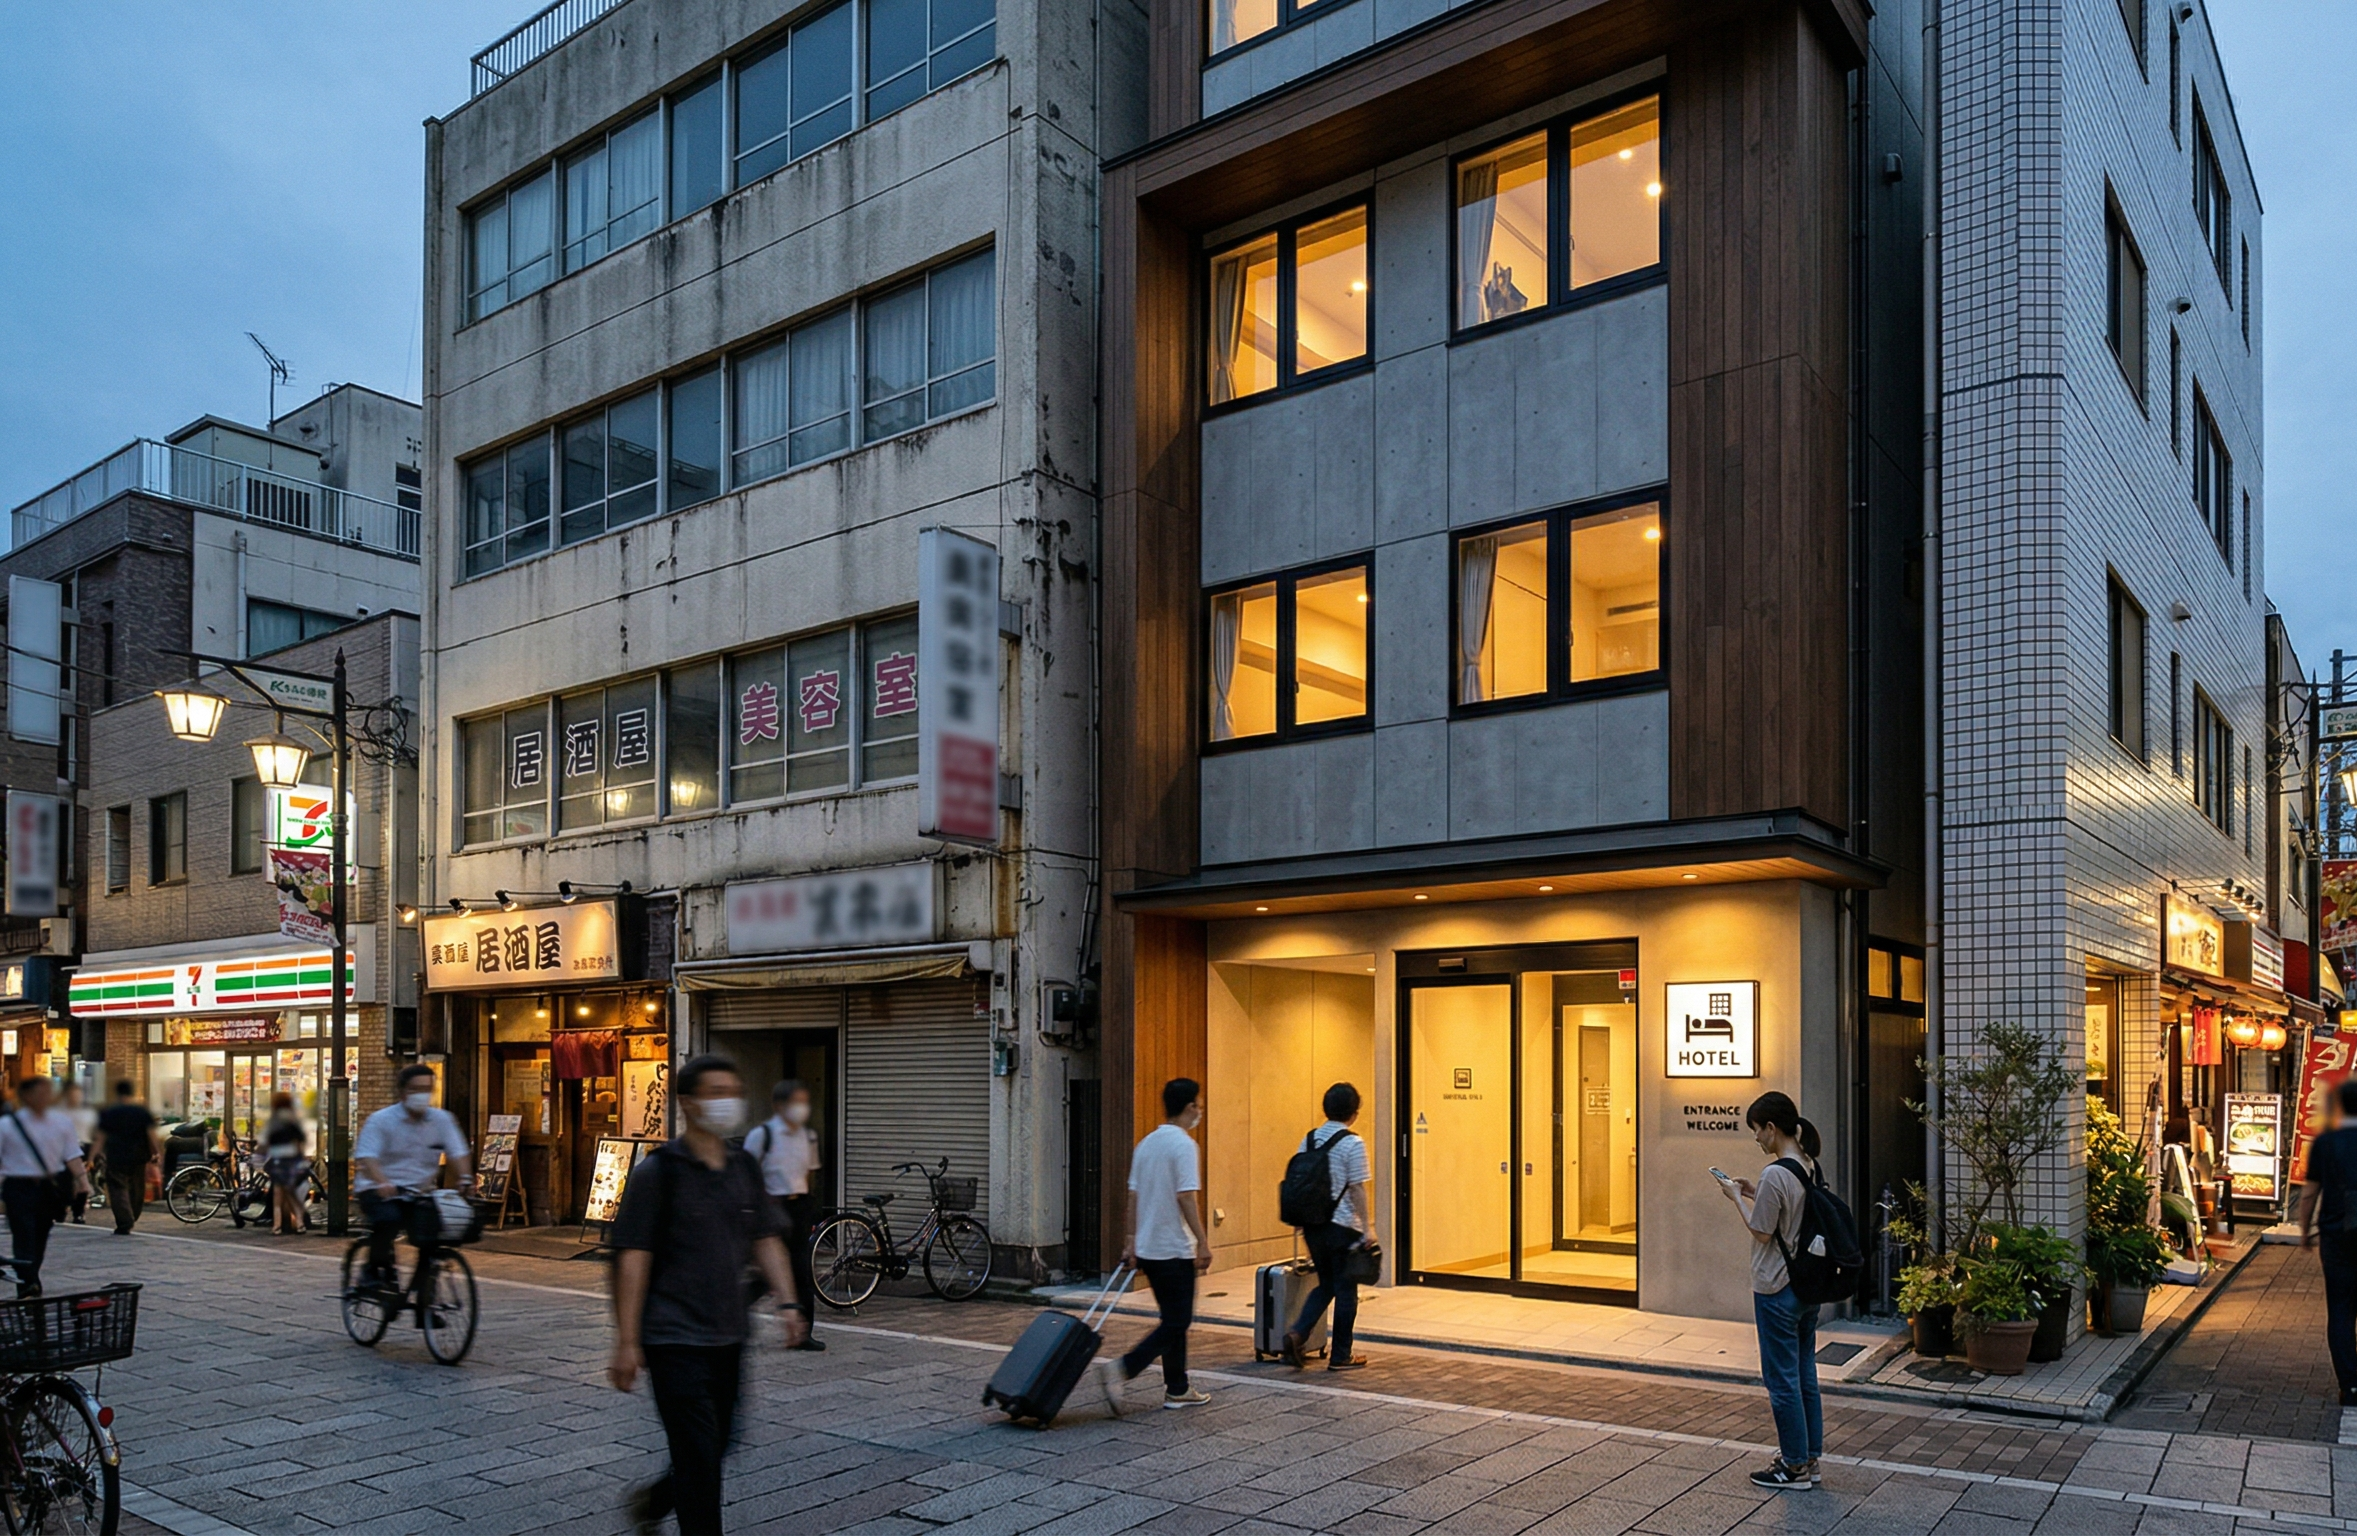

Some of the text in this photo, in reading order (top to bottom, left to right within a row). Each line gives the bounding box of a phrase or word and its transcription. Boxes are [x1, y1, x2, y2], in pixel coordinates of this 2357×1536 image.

[740, 651, 918, 745] 美容室
[511, 708, 648, 789] 居酒屋
[476, 921, 561, 974] 居酒屋
[1679, 1051, 1740, 1066] HOTEL
[1683, 1105, 1740, 1116] ENTRANCE
